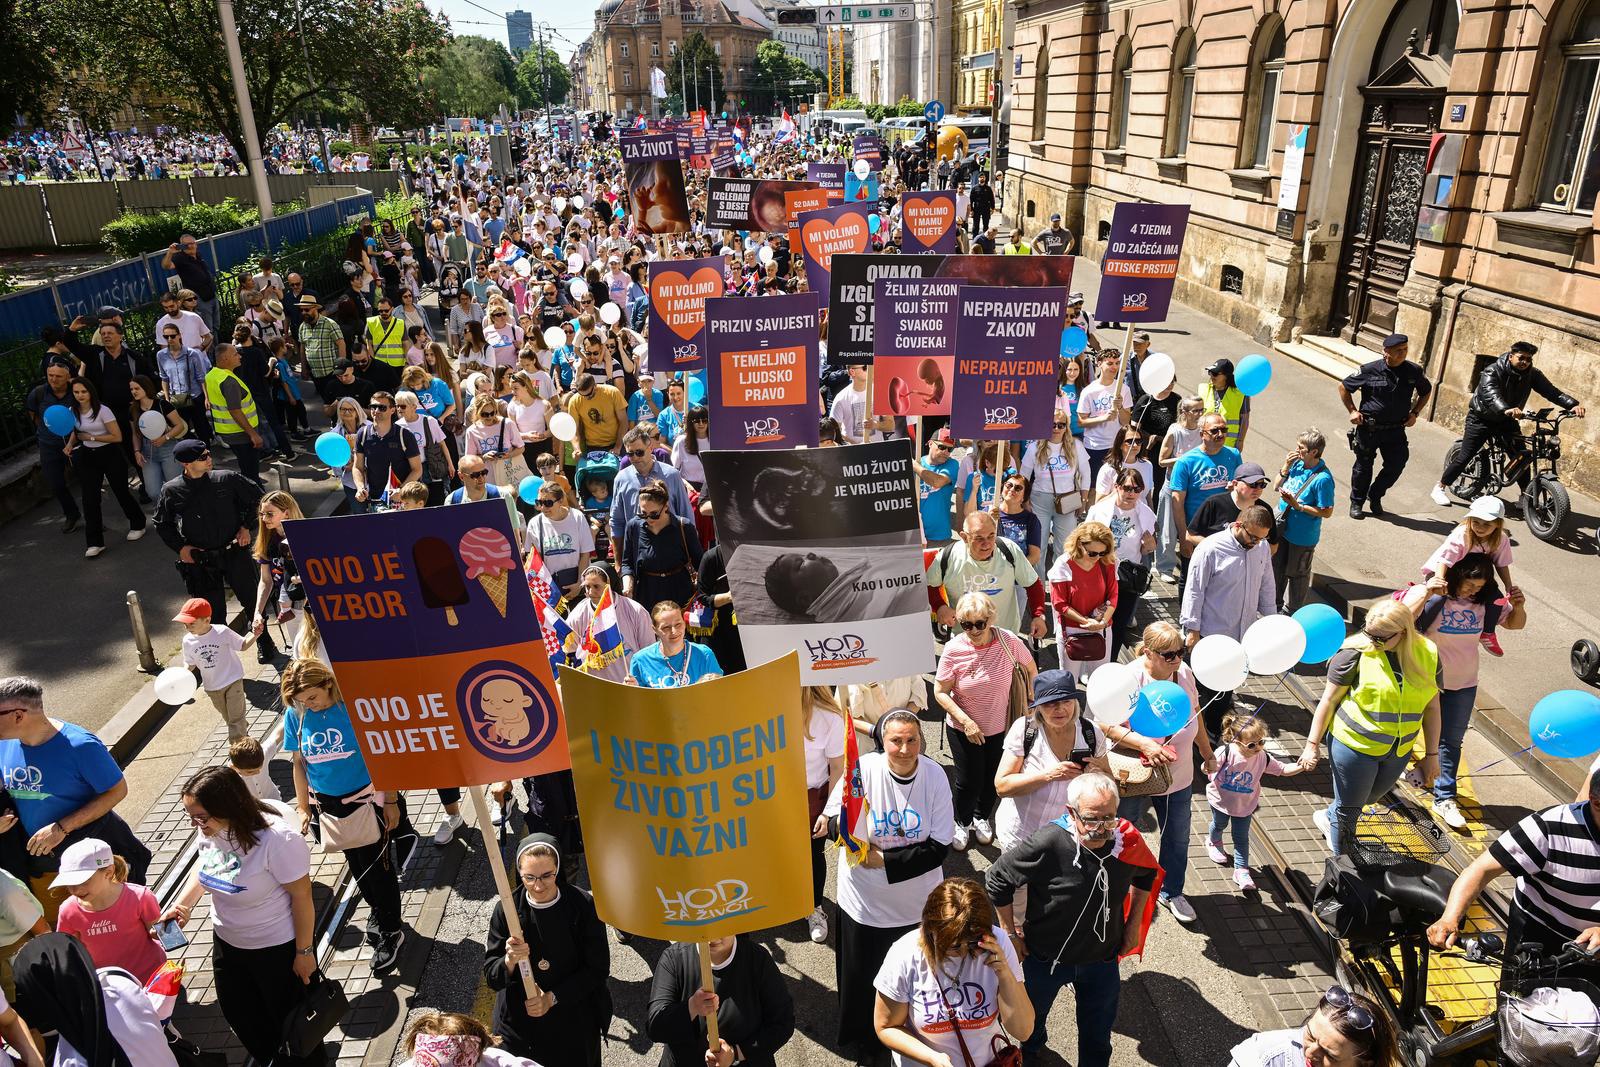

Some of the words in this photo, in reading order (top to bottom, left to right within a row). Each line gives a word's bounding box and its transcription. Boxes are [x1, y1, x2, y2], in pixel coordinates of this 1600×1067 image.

[624, 144, 639, 158] ZA
[640, 140, 673, 157] ŽIVOT
[725, 183, 751, 192] OVAKO
[712, 191, 750, 202] IZGLEDAM
[719, 201, 725, 210] S
[726, 202, 749, 211] DESET
[908, 208, 918, 216] MI
[919, 206, 948, 216] VOLIMO
[716, 210, 748, 220] TJEDANA
[918, 218, 942, 226] MAMU
[809, 231, 822, 244] MI
[823, 225, 860, 242] VOLIMO
[918, 227, 943, 236] DIJETE
[1130, 224, 1138, 235] 4
[1140, 224, 1172, 235] TJEDNA
[818, 245, 822, 254] I
[824, 240, 855, 253] MAMU
[1112, 242, 1126, 253] OD
[1127, 241, 1162, 255] ZAČEĆA
[1163, 244, 1178, 255] IMA
[819, 257, 823, 266] I
[1107, 261, 1141, 274] OTISKE
[1142, 263, 1176, 274] PRSTIJU
[866, 265, 922, 278] OVAKO
[659, 285, 673, 298] MI
[675, 281, 714, 296] VOLIMO
[840, 285, 874, 303] IZGL
[885, 281, 919, 296] ŽELIM
[922, 284, 957, 296] ZAKON
[667, 300, 671, 311] I
[895, 302, 919, 314] KOJI
[921, 299, 948, 313] ŠTITI
[1123, 293, 1147, 304] HOD
[855, 307, 865, 323] S
[963, 301, 1060, 317] NEPRAVEDAN
[667, 313, 671, 325] I
[673, 312, 705, 325] DIJETE
[711, 319, 752, 333] PRIZIV
[755, 315, 814, 332] SAVIJESTI
[900, 319, 943, 331] SVAKOG
[986, 322, 1036, 337] ZAKON
[895, 334, 946, 348] ČOVJEKA!
[673, 344, 697, 356] HOD
[732, 352, 796, 368] TEMELJNO
[959, 360, 1054, 376] NEPRAVEDNA
[739, 369, 793, 385] LJUDSKO
[745, 387, 785, 401] PRAVO
[985, 380, 1028, 395] DJELA
[984, 406, 1017, 419] HOD
[744, 417, 779, 433] HOD
[842, 465, 869, 478] MOJ
[871, 459, 908, 475] ŽIVOT
[834, 485, 848, 498] JE
[850, 479, 911, 496] VRIJEDAN
[874, 497, 913, 513] OVDJE
[305, 555, 365, 586] OVO
[373, 551, 406, 582] JE
[852, 580, 876, 592] KAO
[879, 578, 884, 590] I
[886, 574, 922, 589] OVDJE
[318, 590, 407, 622] IZBOR
[804, 634, 865, 656] HOD
[811, 652, 829, 661] ZA
[832, 649, 869, 661] ŽIVOT
[354, 696, 411, 723] OVO
[416, 693, 449, 719] JE
[300, 728, 343, 752] HOD
[364, 725, 460, 755] DIJETE
[591, 729, 600, 764] I
[610, 714, 786, 778] NEROĐENI
[3, 765, 43, 785] HOD
[609, 767, 720, 819] ŽIVOTI
[732, 765, 776, 807] SU
[872, 809, 920, 831] HOD
[647, 815, 748, 858] VAŽNI
[874, 829, 890, 838] ZA
[656, 879, 750, 912] HOD
[664, 909, 690, 921] ZA
[696, 896, 753, 921] ŽIVOT
[87, 924, 117, 937] SUMMER
[92, 919, 111, 930] hello
[921, 982, 985, 1013] HOD
[924, 1012, 946, 1023] ZA
[957, 1003, 990, 1021] IVOT
